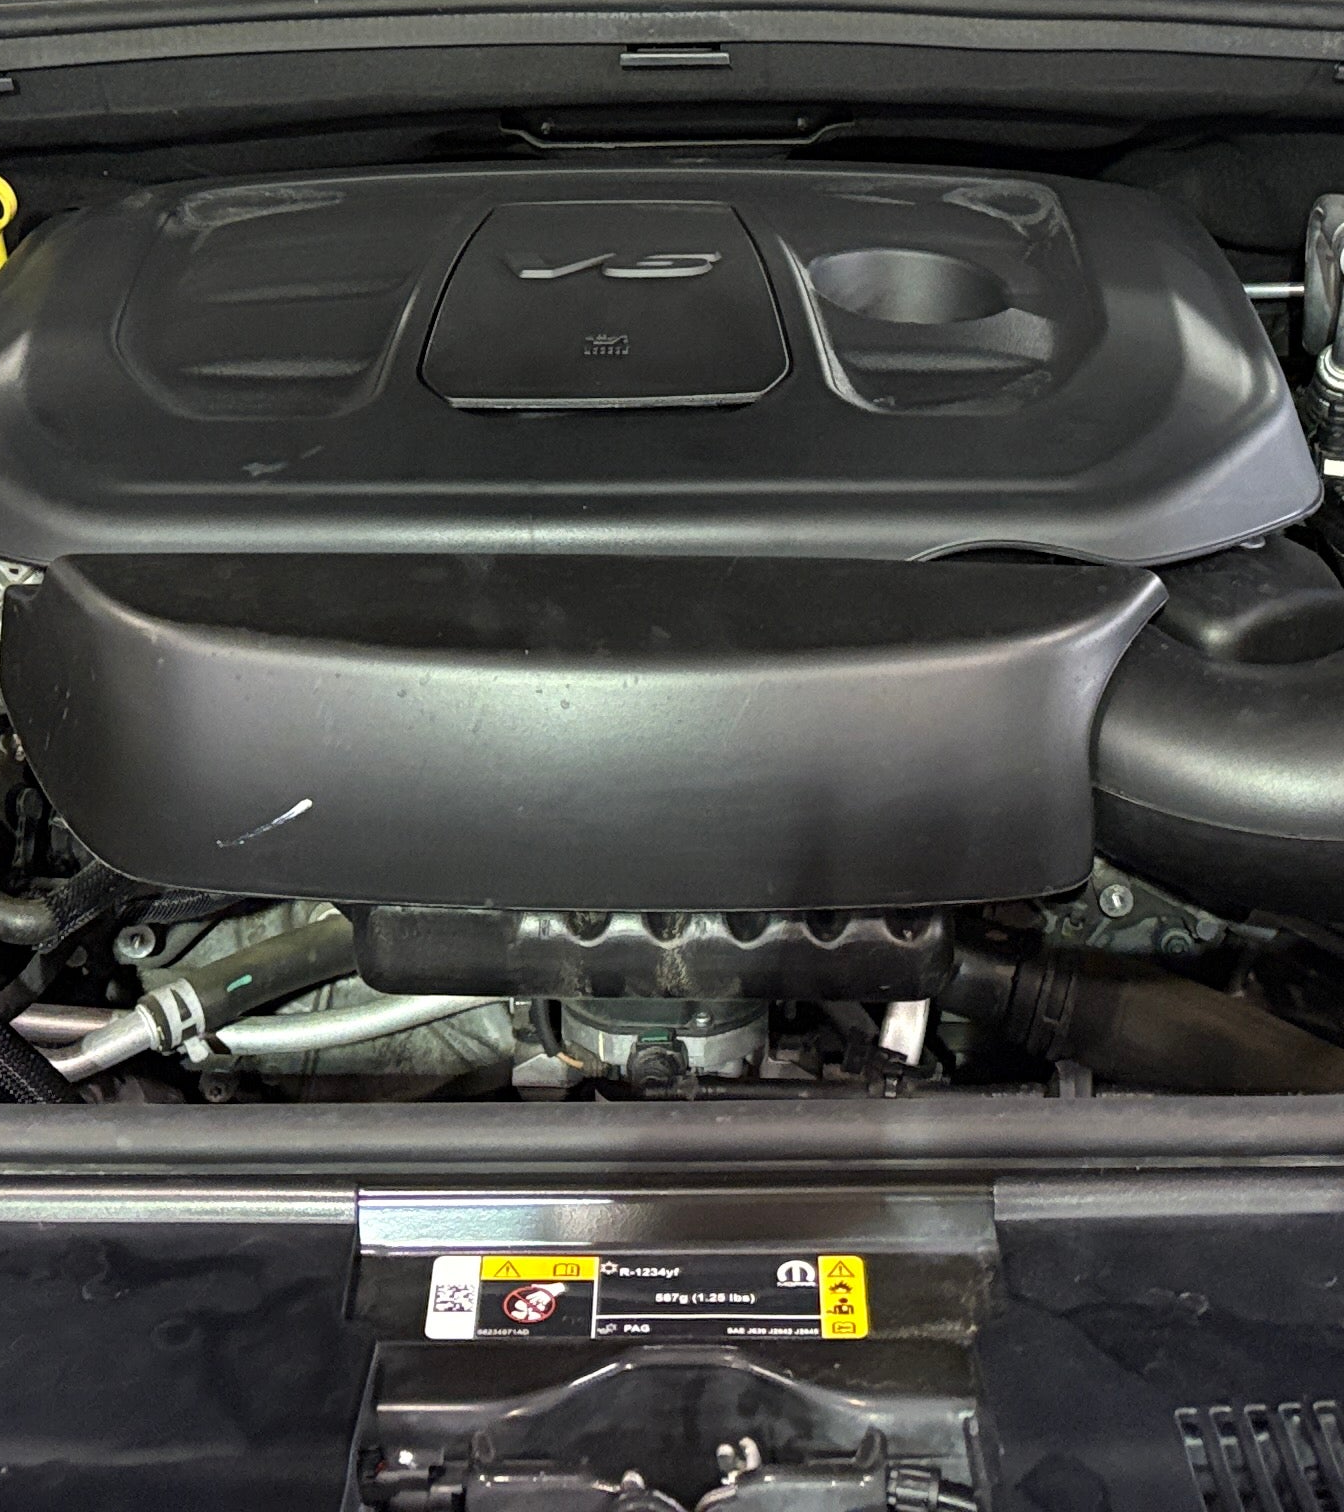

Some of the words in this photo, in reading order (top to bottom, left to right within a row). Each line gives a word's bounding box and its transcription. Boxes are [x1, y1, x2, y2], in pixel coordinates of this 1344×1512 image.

[619, 1267, 680, 1278] R-1234yf
[691, 1292, 725, 1304] (1.25
[730, 1292, 756, 1305] lbs)
[623, 1325, 650, 1334] PAG
